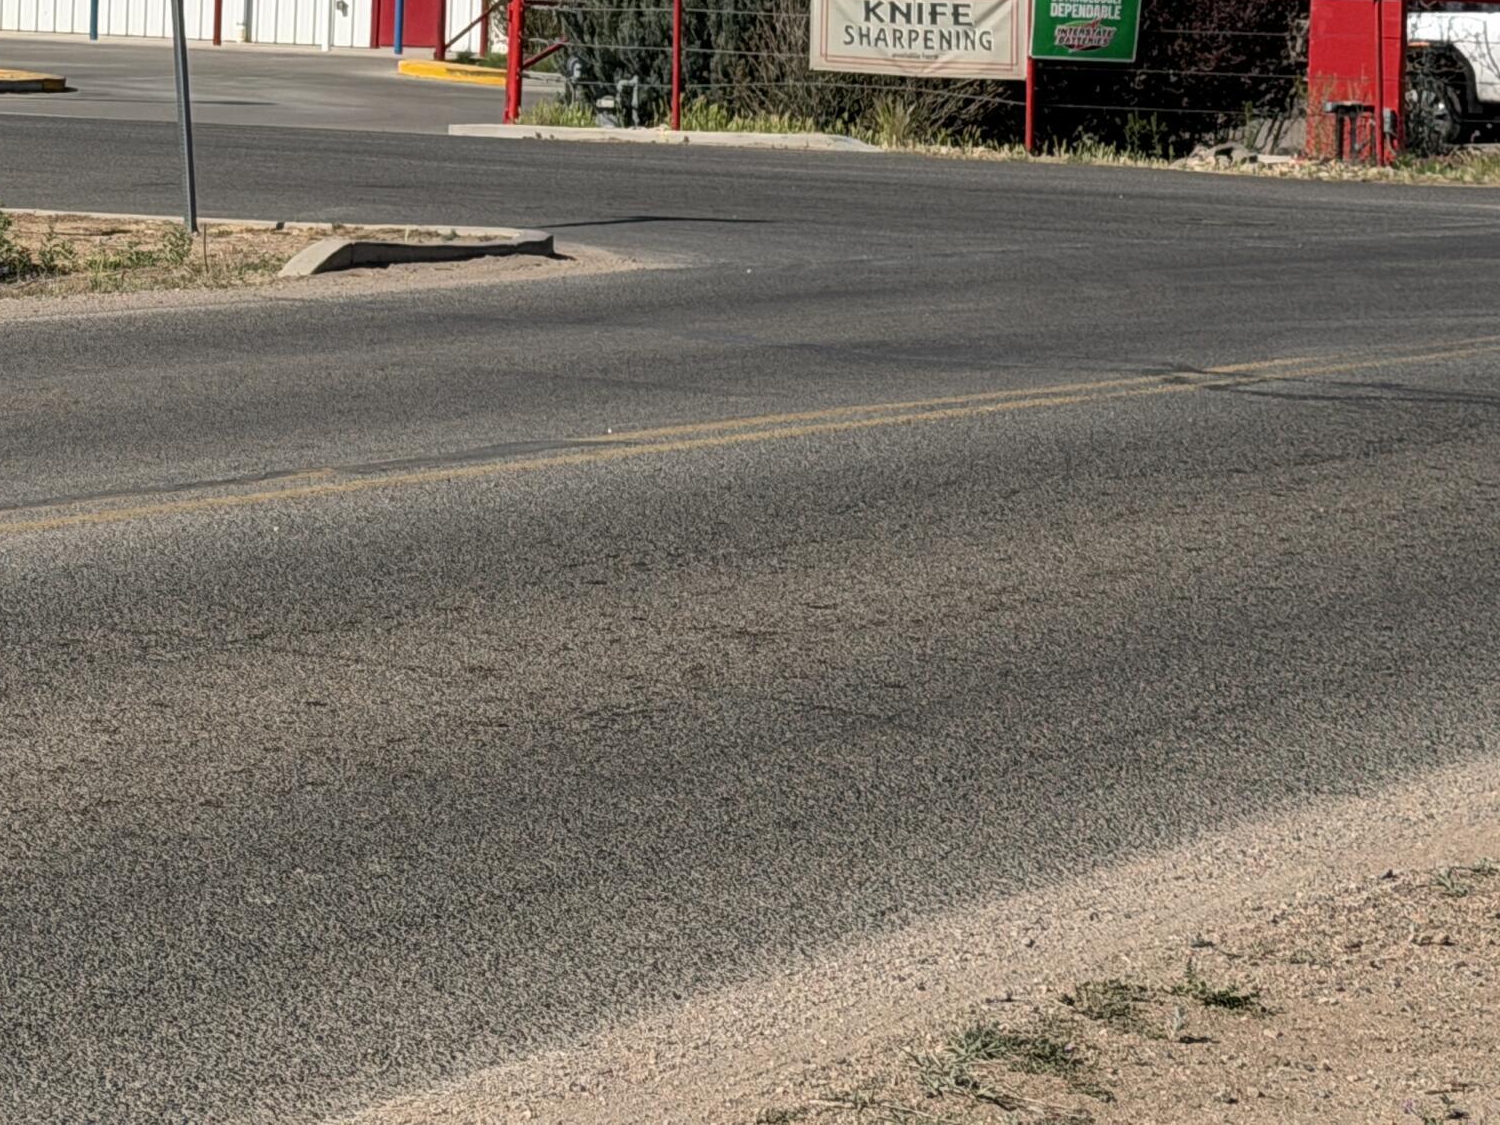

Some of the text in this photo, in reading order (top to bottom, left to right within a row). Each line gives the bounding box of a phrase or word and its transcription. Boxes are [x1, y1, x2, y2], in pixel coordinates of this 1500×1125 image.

[864, 0, 973, 26] KNIFE
[1050, 3, 1122, 20] DEPENDABLE
[843, 25, 992, 52] SHARPENING
